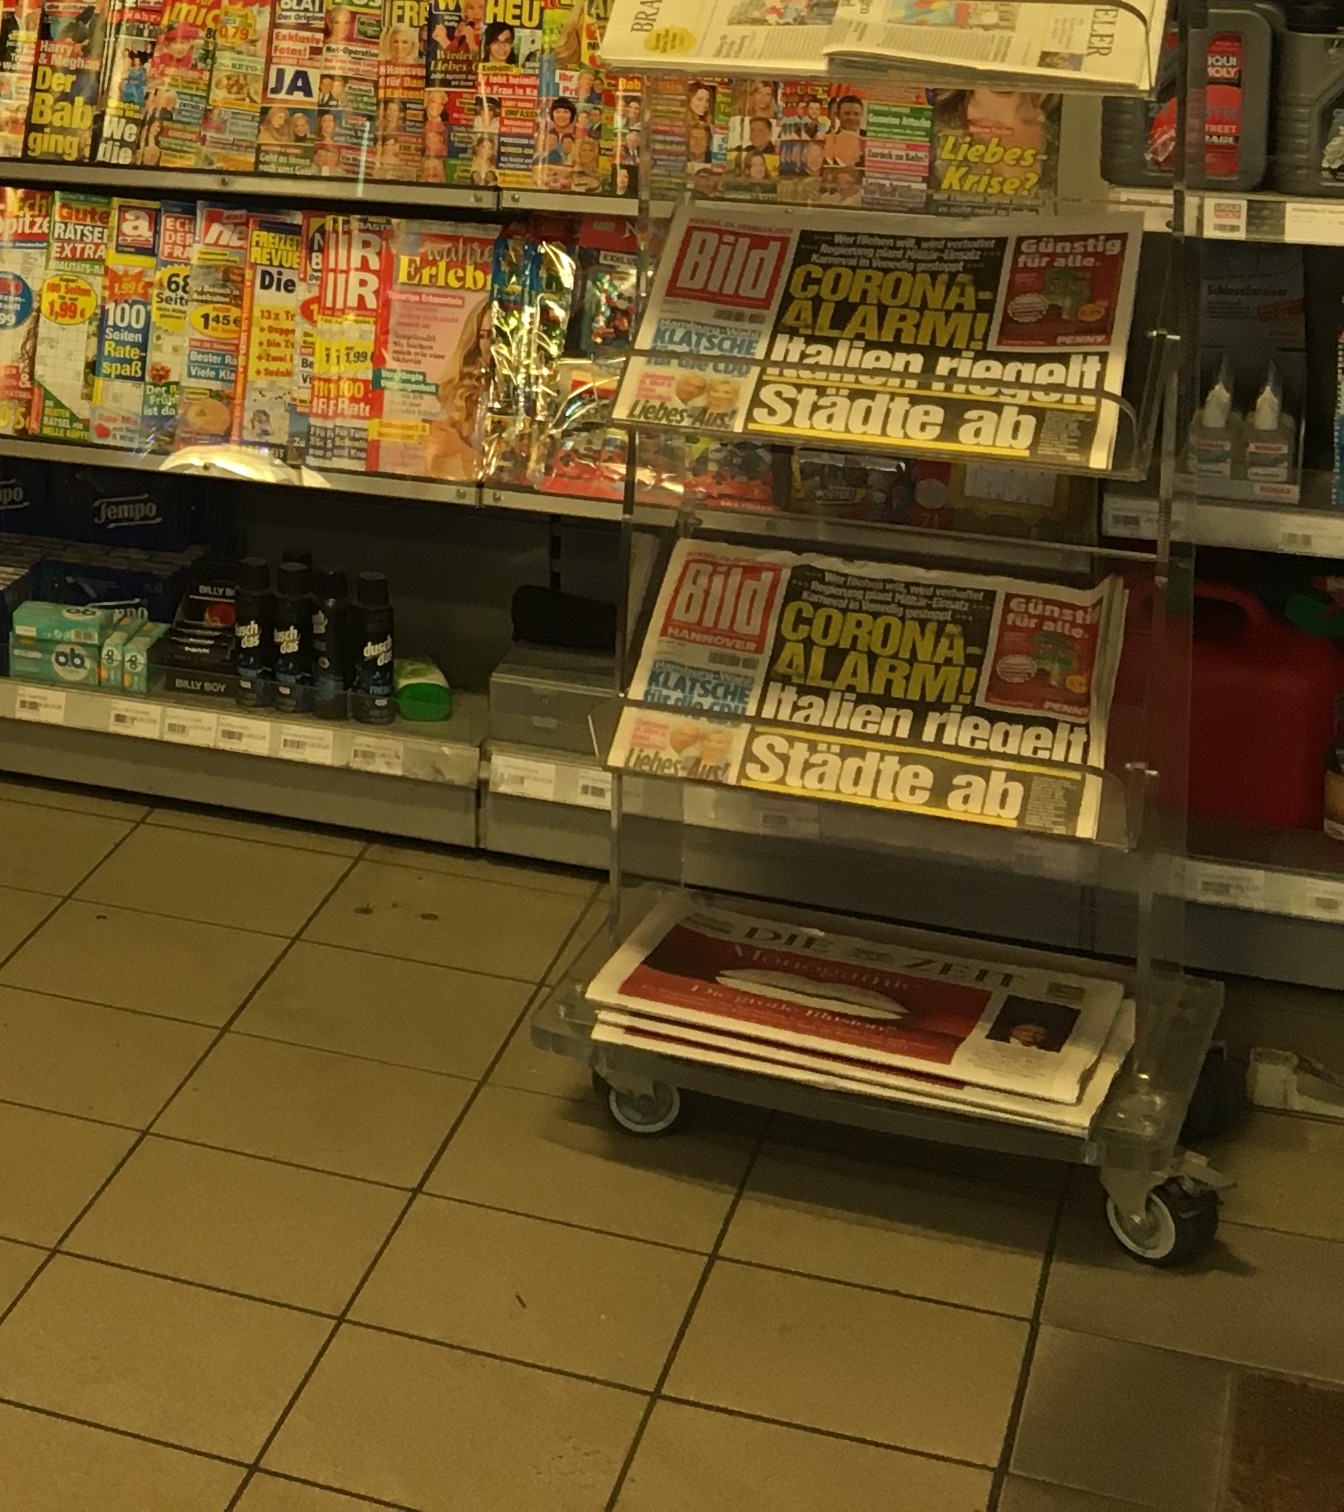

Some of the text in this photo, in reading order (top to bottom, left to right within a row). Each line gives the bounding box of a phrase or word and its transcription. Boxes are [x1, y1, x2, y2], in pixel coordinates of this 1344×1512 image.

[219, 25, 249, 39] 0,79
[39, 40, 74, 55] Harry
[273, 45, 307, 58] Fotos!
[39, 53, 100, 71] & Meghan
[36, 66, 76, 91] Der
[27, 128, 79, 161] ging
[940, 135, 1048, 166] Liebes-
[942, 165, 1039, 196] Krise?
[52, 241, 106, 260] EXTRA
[251, 248, 300, 266] REVUE
[1020, 236, 1122, 256] Günstig
[676, 230, 782, 300] Bild
[1018, 252, 1101, 269] für alle.
[259, 269, 296, 294] Die
[788, 264, 995, 312] CORONA-
[48, 301, 77, 319] 1,99
[105, 328, 142, 342] Seiten
[779, 301, 989, 351] ALARM!
[104, 342, 146, 360] Rate-
[653, 326, 758, 357] KLATSCHE
[1056, 334, 1106, 346] PENNY
[752, 383, 1036, 449] Städte ab
[199, 585, 223, 595] BILLY
[669, 561, 775, 638] Bild
[666, 626, 757, 652] HANNOVER
[780, 601, 984, 666] CORONA-
[1007, 614, 1090, 639] für alle.
[175, 678, 226, 693] BILLY BOY
[646, 670, 751, 704] KLATSCHE
[774, 643, 978, 706] ALARM!
[744, 734, 1026, 820] Städte ab
[745, 926, 833, 955] DIE
[904, 954, 1024, 988] ZEIT
